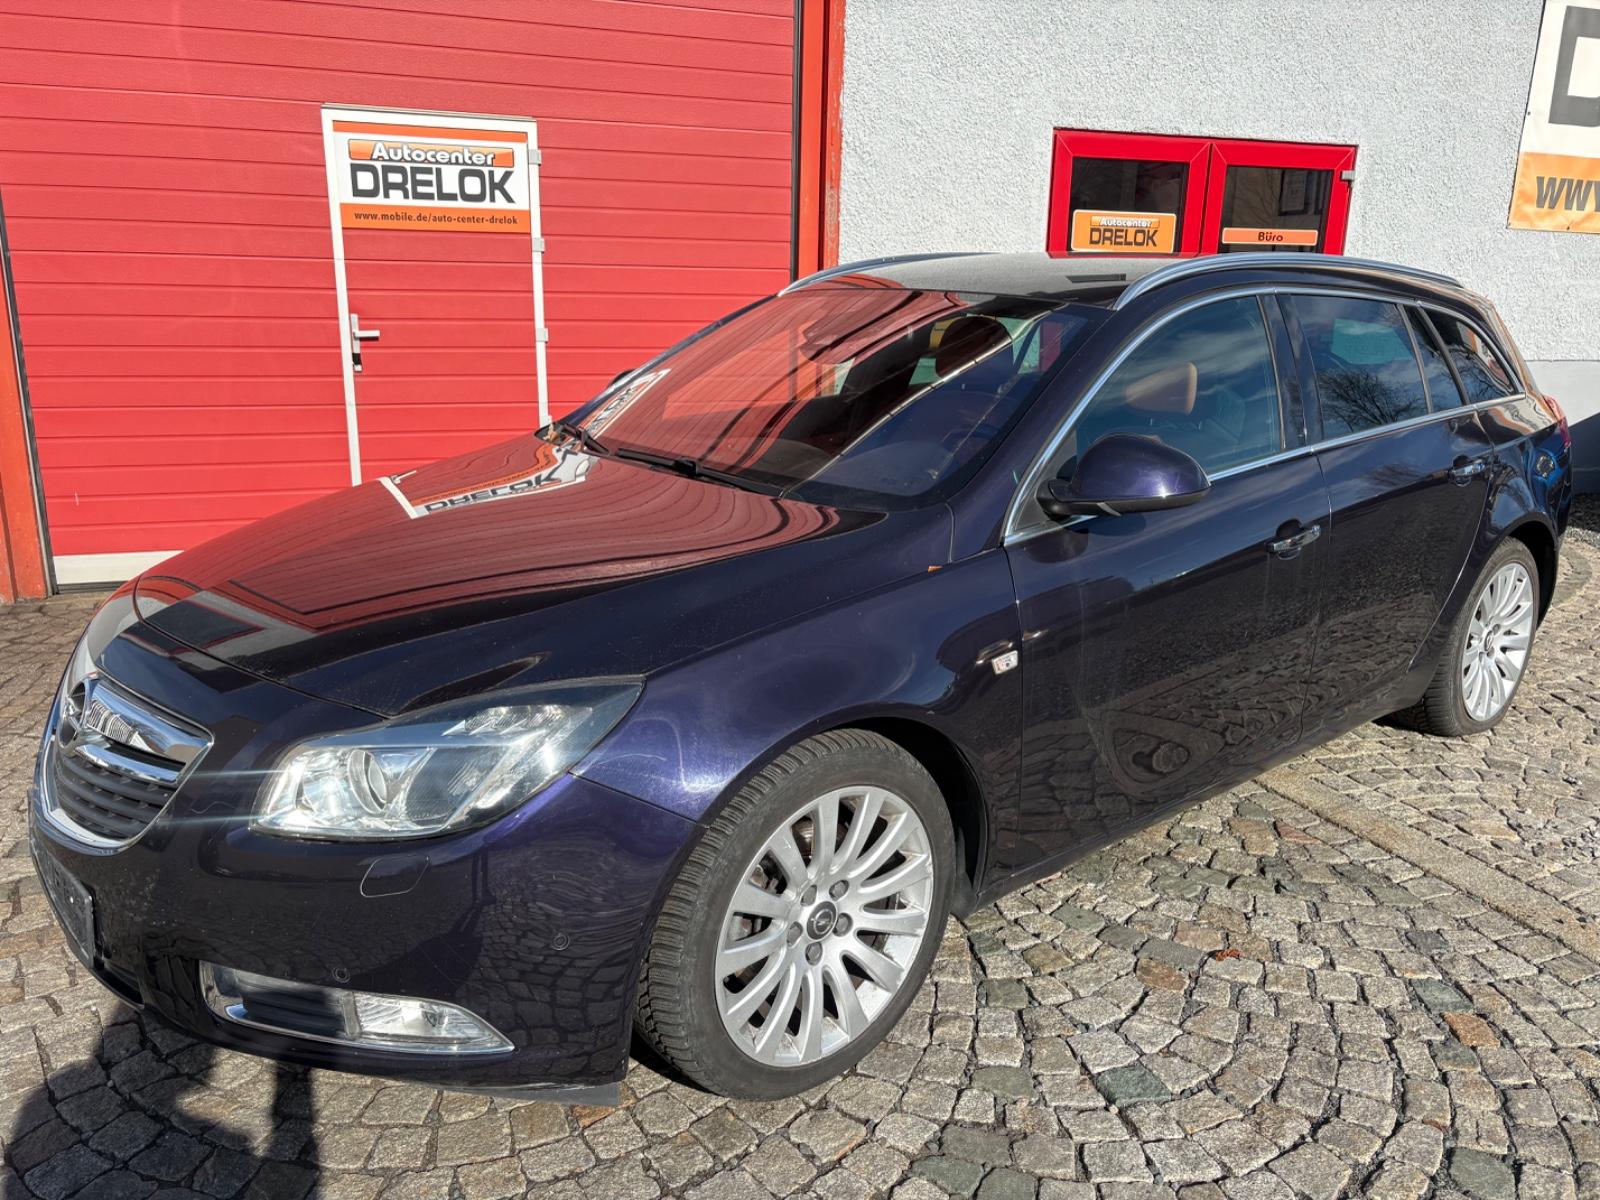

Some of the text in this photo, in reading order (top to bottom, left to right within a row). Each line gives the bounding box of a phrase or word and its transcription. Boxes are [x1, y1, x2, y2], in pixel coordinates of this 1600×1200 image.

[372, 142, 495, 165] Autocenter
[350, 163, 516, 203] DRELOK
[354, 211, 518, 225] www.mobile.de/auto-center-drelok
[1099, 217, 1152, 228] Autocenter
[1089, 227, 1158, 247] DRELOK
[1257, 231, 1284, 242] Büro
